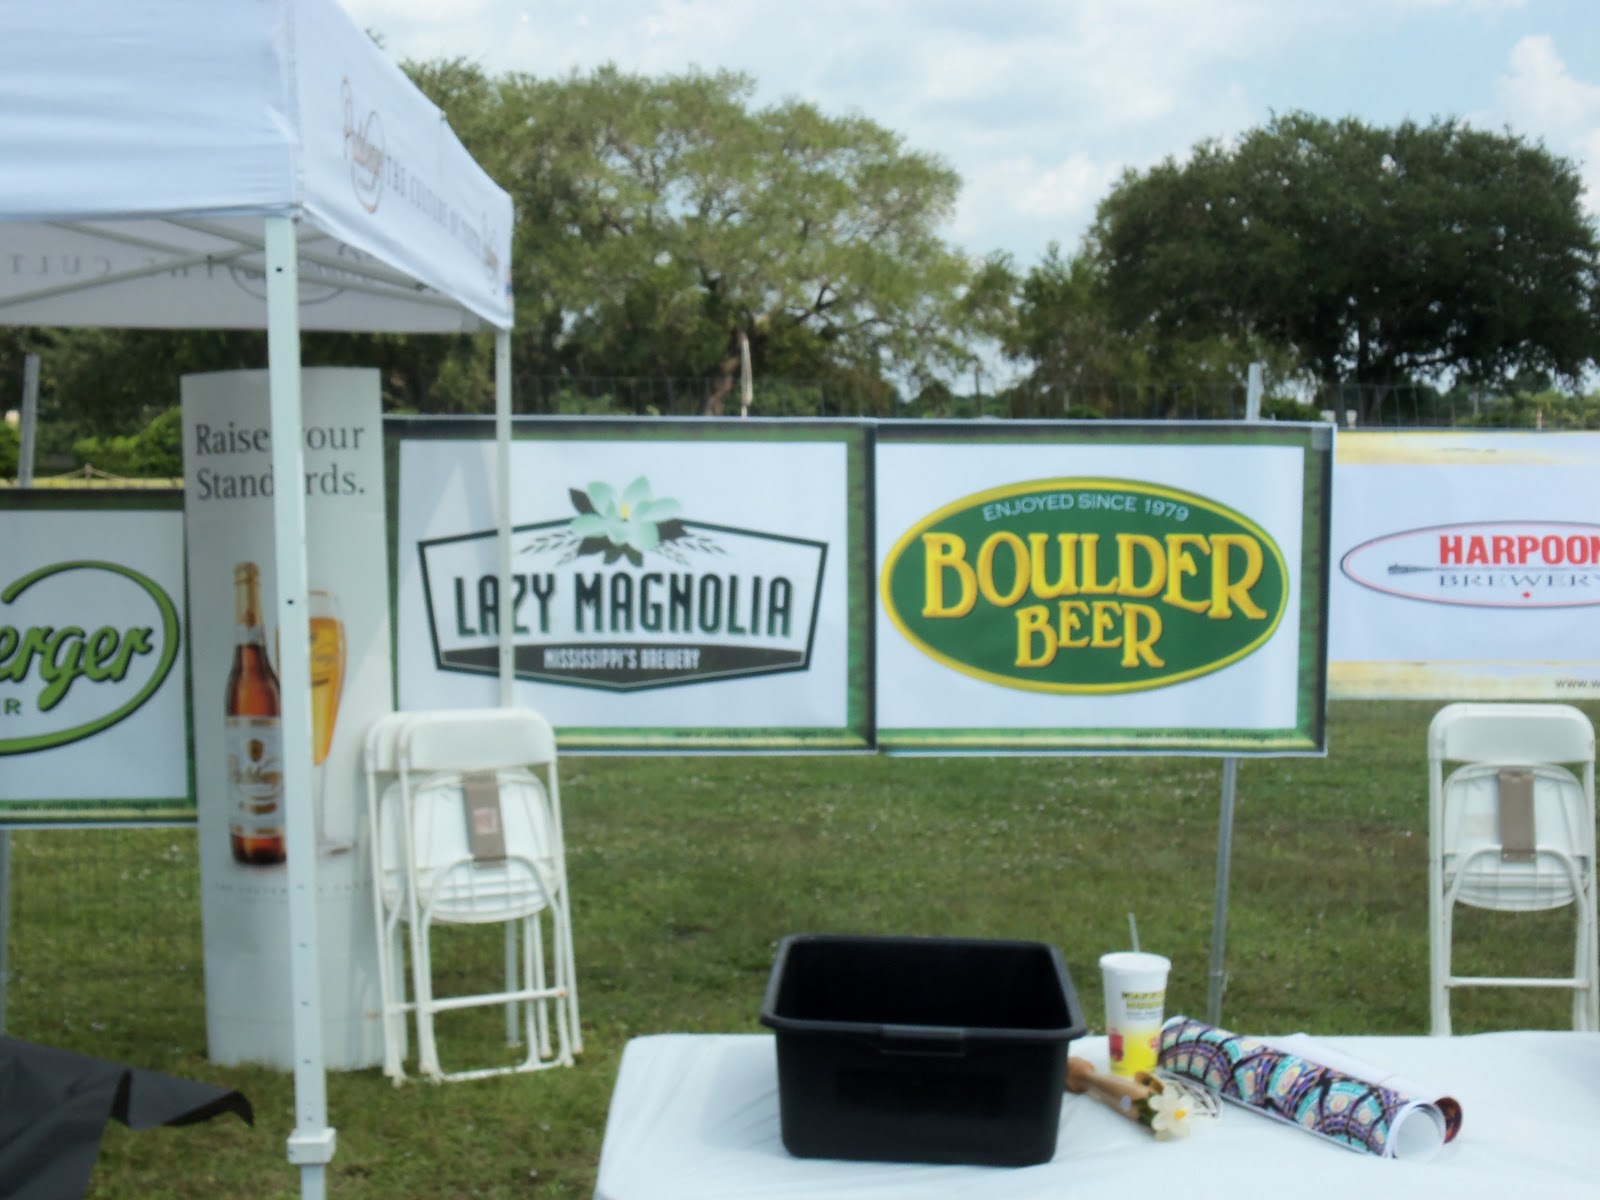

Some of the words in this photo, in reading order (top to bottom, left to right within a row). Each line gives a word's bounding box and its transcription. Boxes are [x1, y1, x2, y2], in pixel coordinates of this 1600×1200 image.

[195, 420, 269, 455] Raise
[302, 425, 365, 450] our
[196, 463, 366, 500] Standrds.
[982, 493, 1075, 522] ENJOYED
[1078, 493, 1138, 513] SINCE
[1144, 498, 1190, 523] 1979
[921, 531, 1267, 619] BOULDER
[453, 572, 555, 638] LAZY
[574, 571, 794, 639] MAGNOLIA
[1014, 601, 1166, 668] BEER
[639, 648, 700, 670] BREWERY
